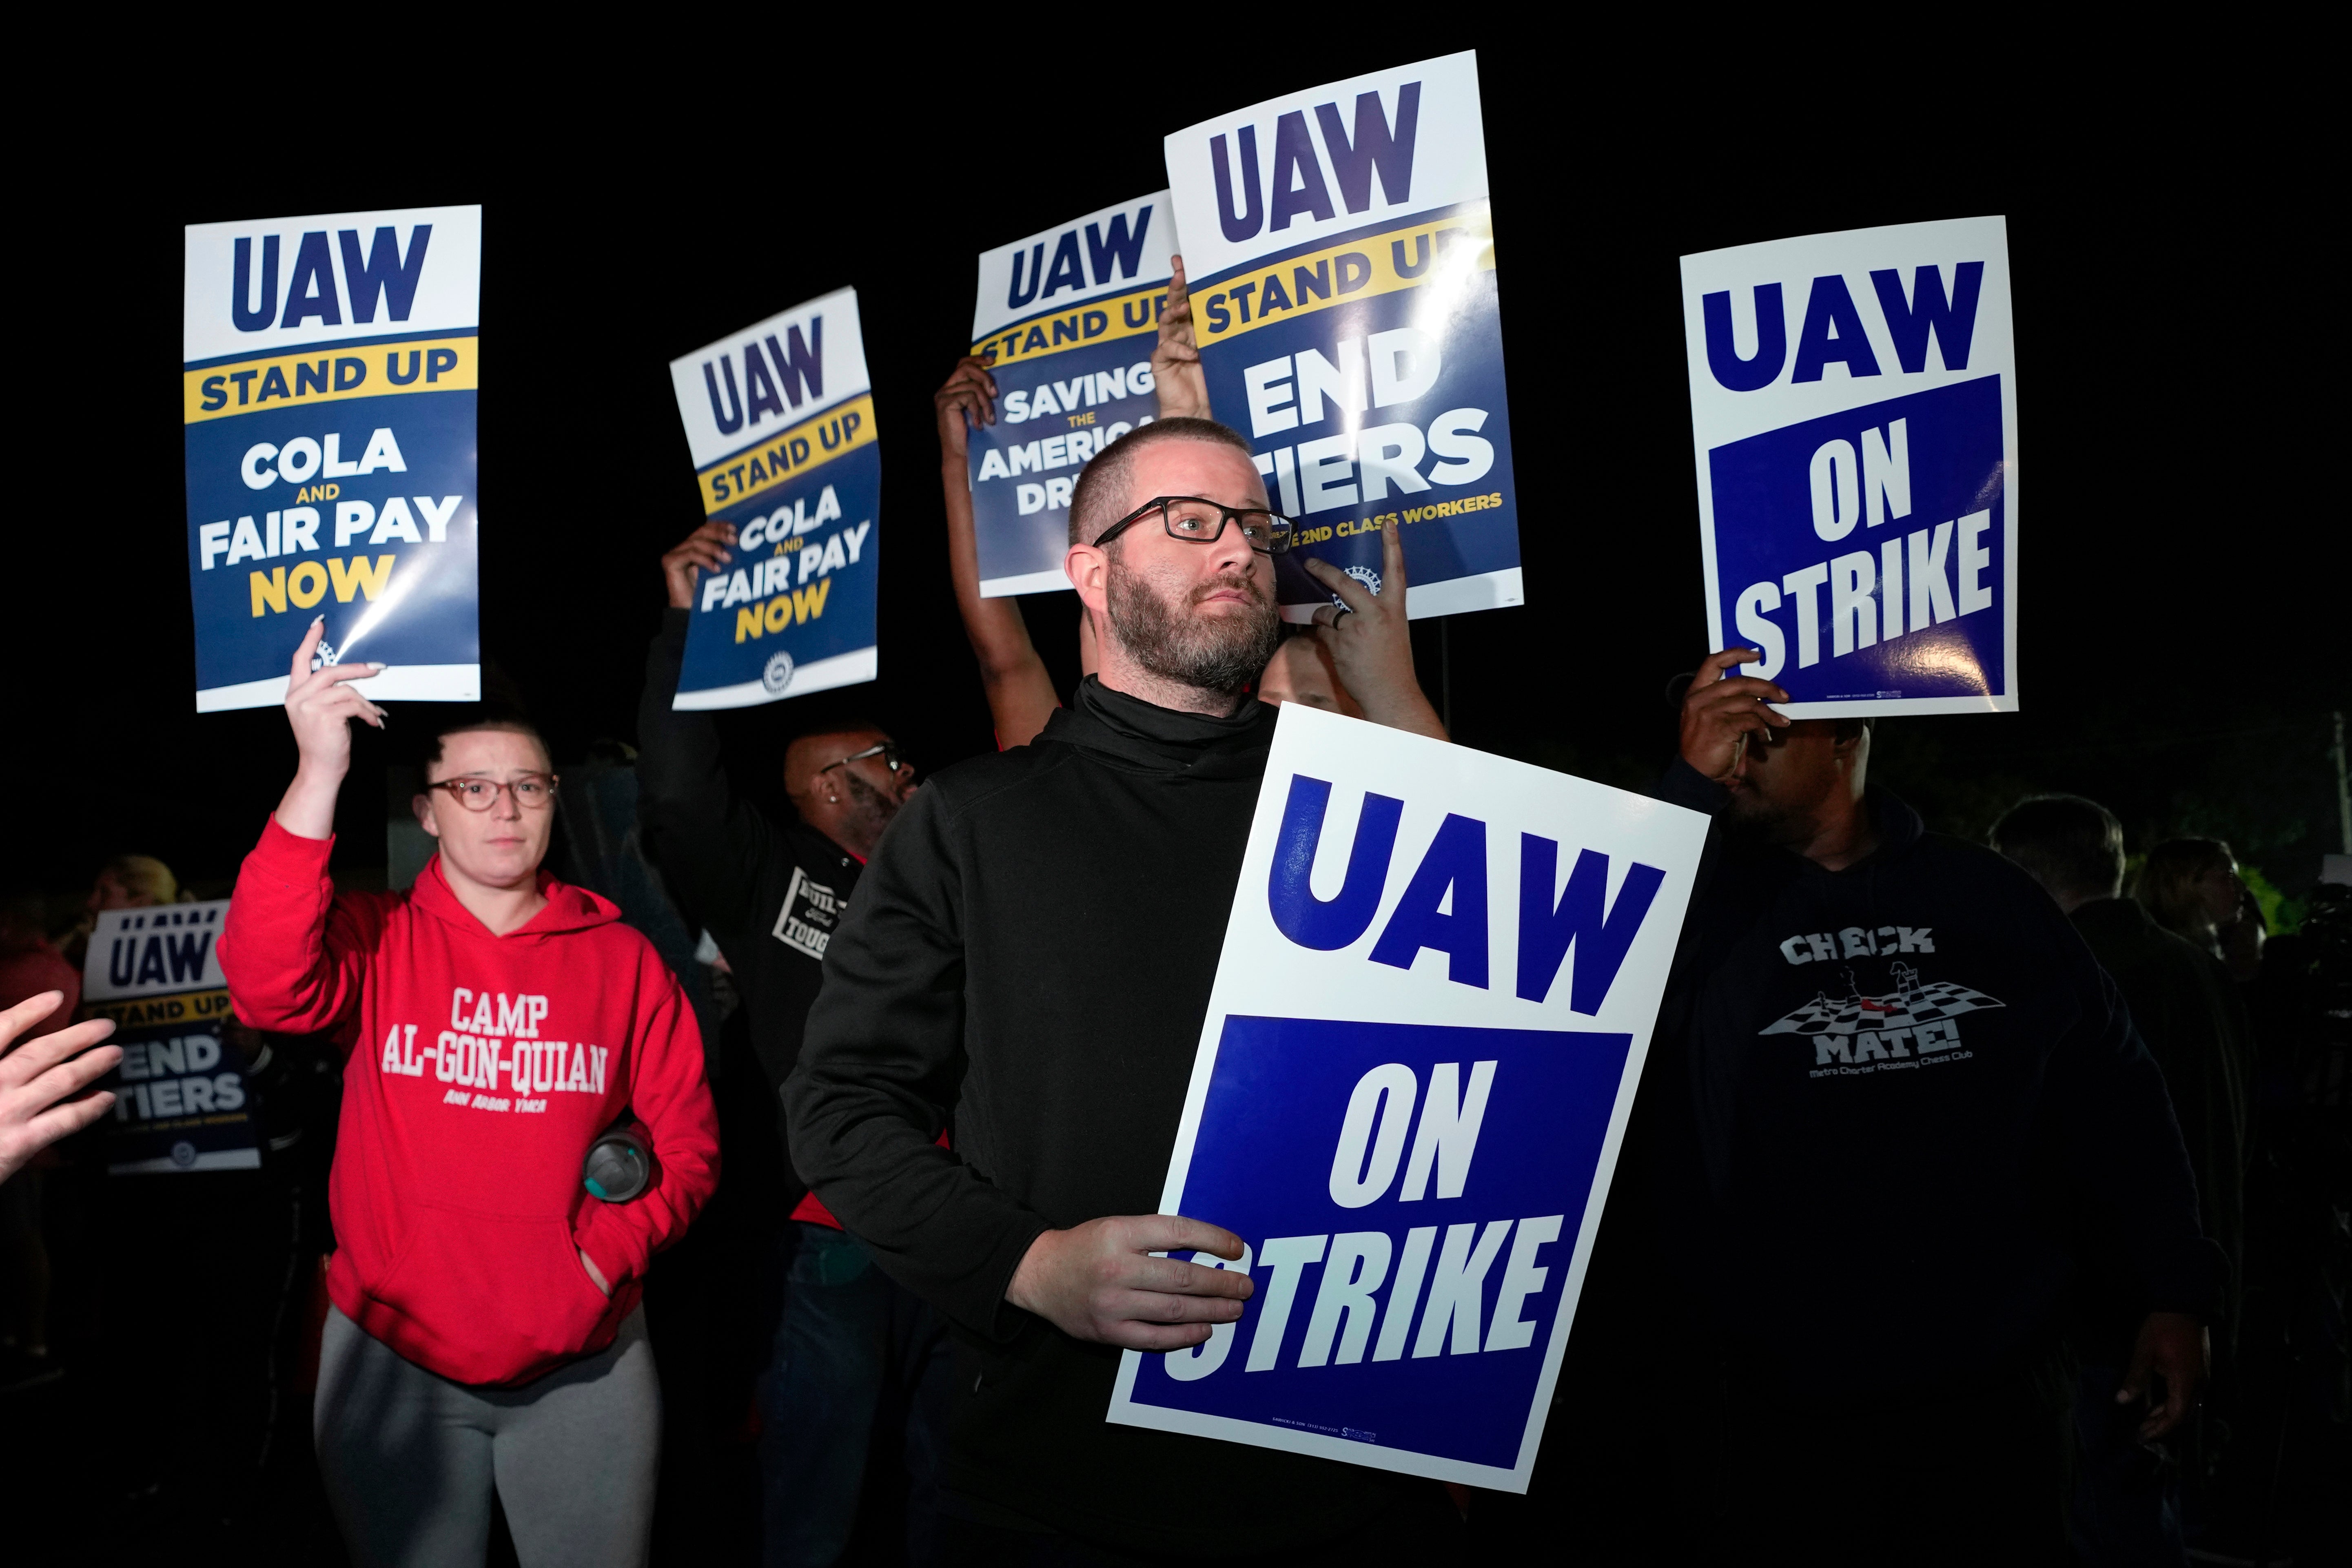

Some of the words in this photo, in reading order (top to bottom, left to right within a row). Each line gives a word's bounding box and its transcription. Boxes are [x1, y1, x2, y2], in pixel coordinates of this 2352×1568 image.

[1210, 81, 1422, 243] UAW
[232, 224, 433, 331] UAW
[1008, 204, 1153, 310] UAW
[1206, 252, 1372, 334] STAND
[1702, 261, 1984, 392] UAW
[200, 357, 366, 411] STAND
[386, 348, 457, 385] UP
[702, 314, 823, 436] UAW
[1004, 362, 1156, 424] SAVING
[1244, 327, 1441, 439] END
[1068, 412, 1096, 428] THE
[241, 428, 407, 489] COLA
[711, 436, 810, 502] STAND
[818, 412, 861, 452] UP
[1252, 408, 1494, 518] IERS
[1810, 417, 1911, 542] ON
[296, 483, 339, 504] AND
[739, 484, 842, 552] COLA
[1302, 526, 1332, 545] 2ND
[1336, 512, 1399, 538] CLASS
[1402, 492, 1503, 524] WORKERS
[200, 506, 319, 571] FAIR
[335, 496, 463, 547] PAY
[701, 556, 791, 613] FAIR
[798, 519, 871, 584] PAY
[774, 536, 804, 556] AND
[250, 554, 395, 617] NOW
[735, 576, 831, 644] NOW
[1736, 509, 1992, 681] STRIKE
[1268, 773, 1666, 1017] UAW
[111, 932, 211, 986] UAW
[786, 915, 830, 953] TOUG
[1779, 926, 1935, 966] CHECK
[195, 996, 228, 1014] UP
[451, 987, 548, 1039] CAMP
[120, 1034, 222, 1081] END
[382, 1023, 608, 1097] AL-GON-QUIAN
[1812, 1019, 1962, 1065] MATE!
[1951, 1050, 1973, 1060] Club
[108, 1072, 246, 1123] TIERS
[1329, 1061, 1497, 1208] ON
